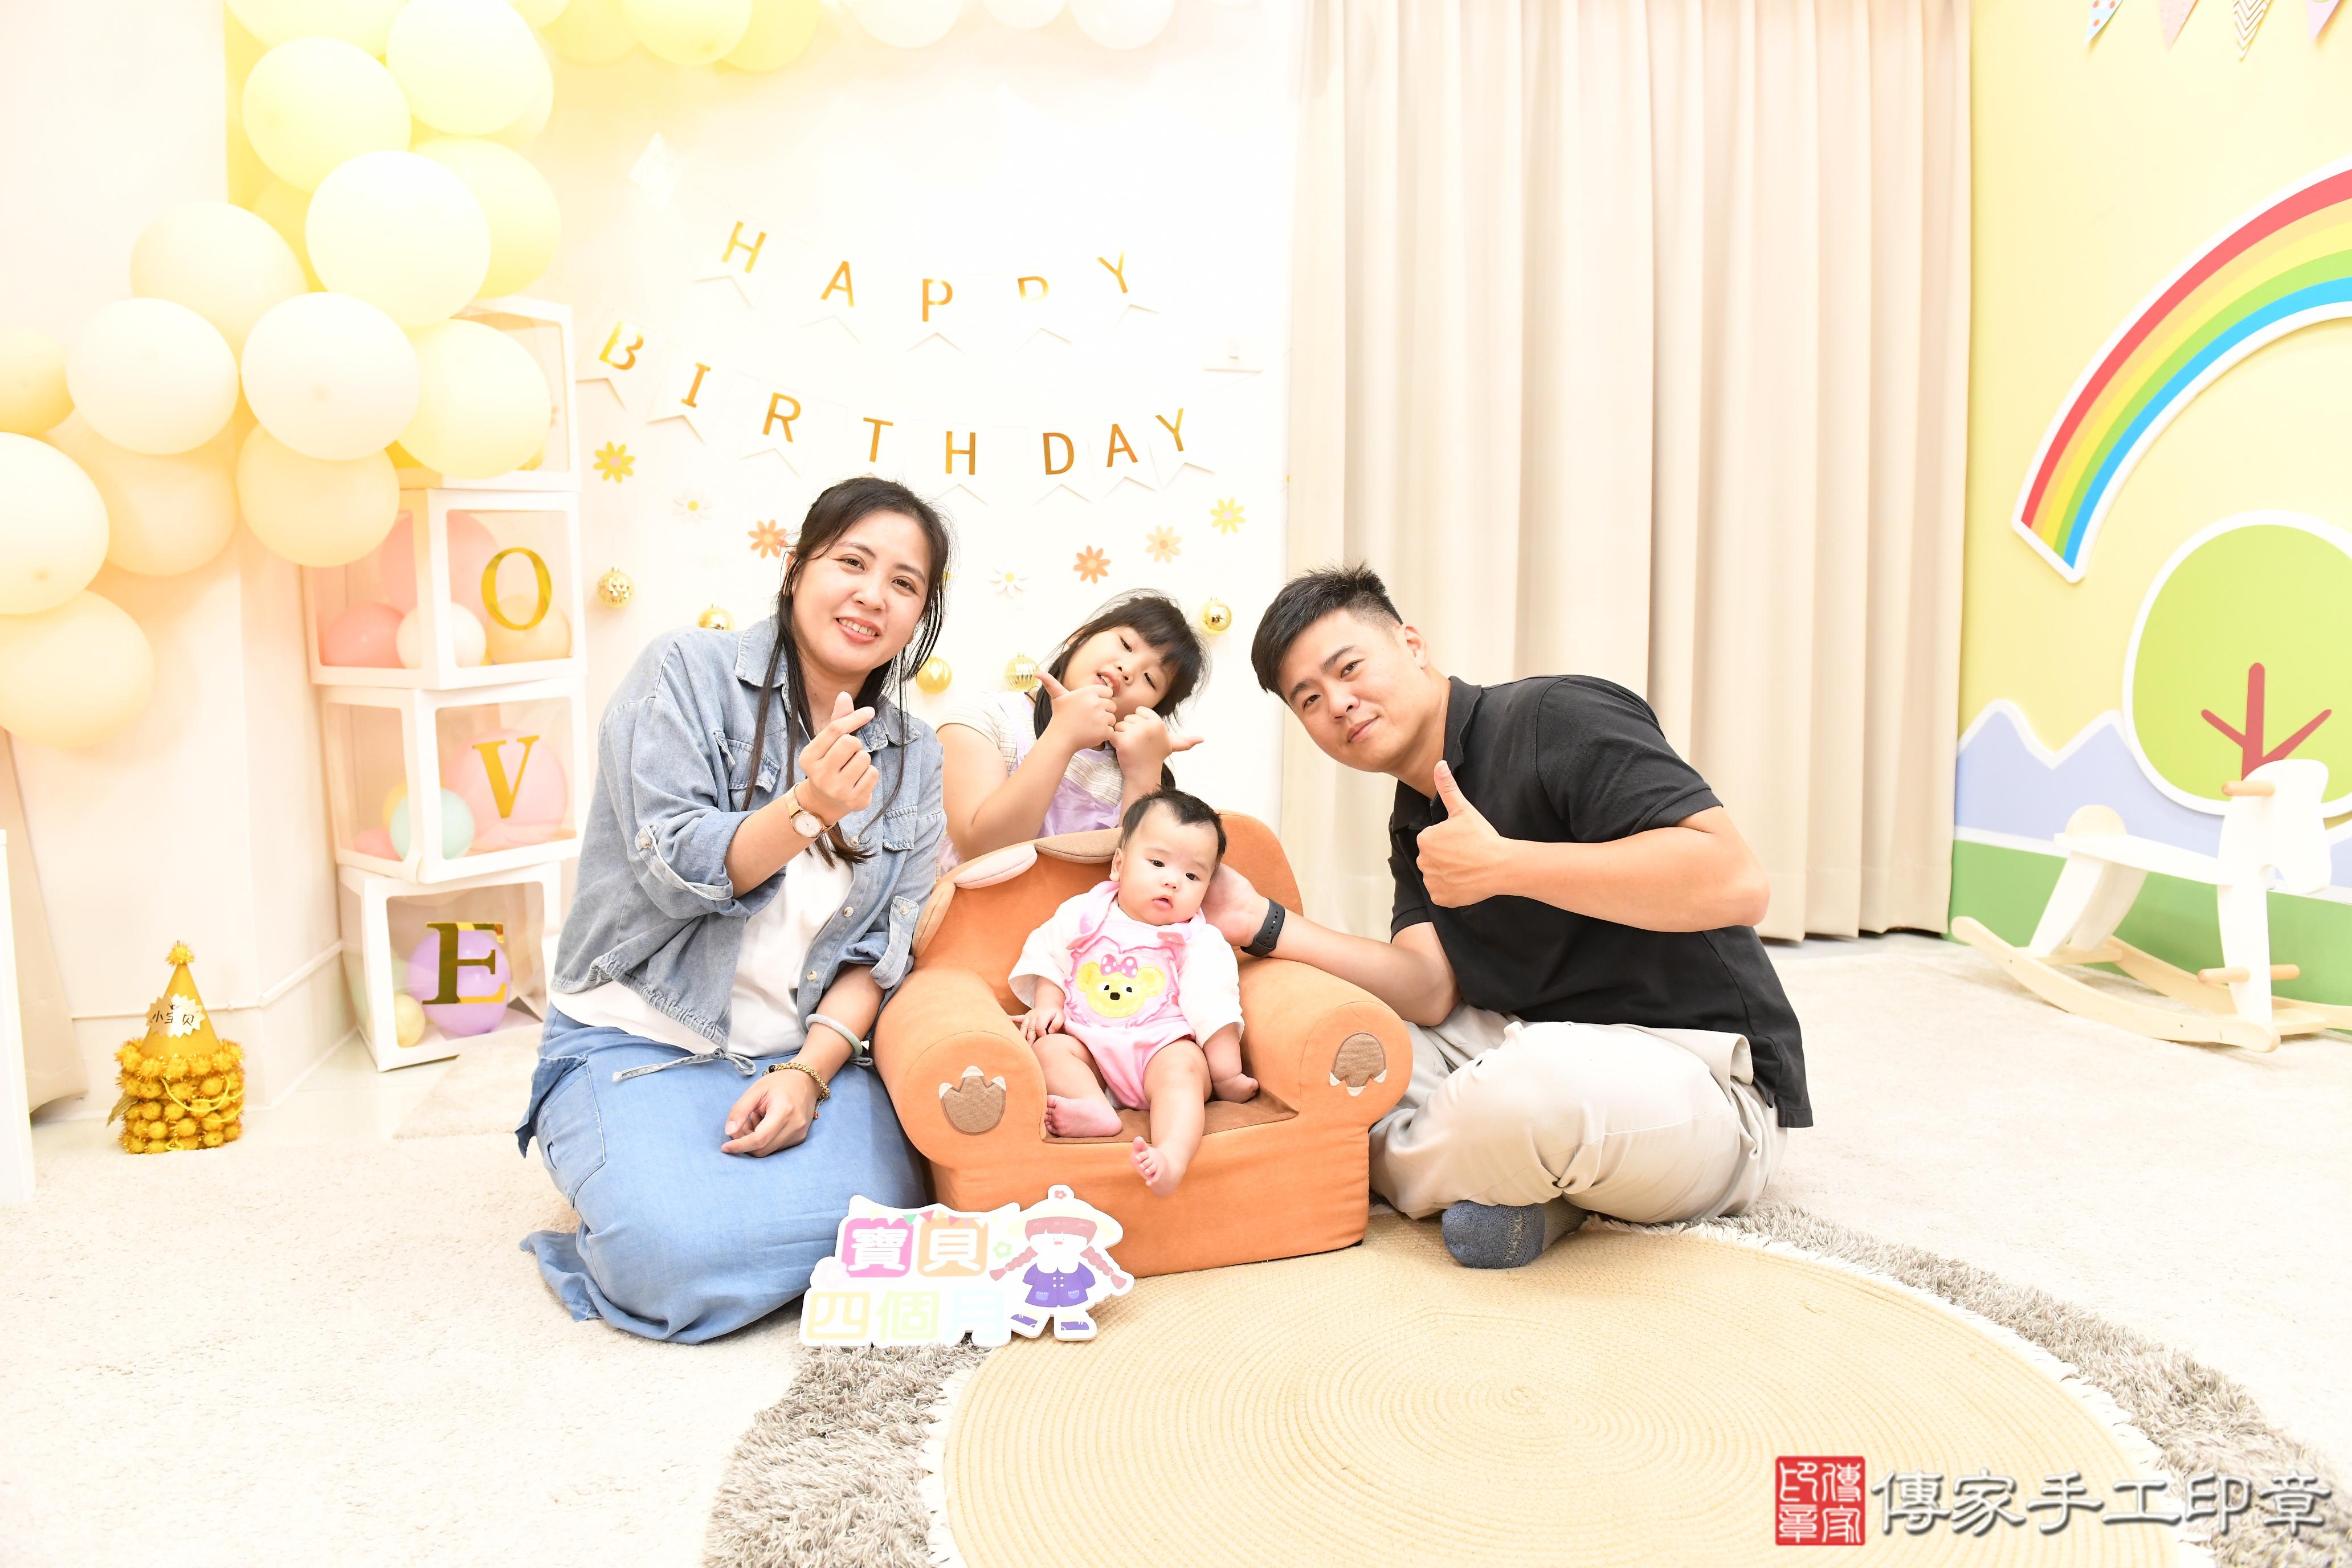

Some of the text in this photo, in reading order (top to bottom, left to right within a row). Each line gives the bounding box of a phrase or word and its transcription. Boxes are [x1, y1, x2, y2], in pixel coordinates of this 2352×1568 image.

[720, 220, 1129, 322] HAPPY
[598, 320, 1186, 476] BIRTHDAY
[847, 1224, 984, 1272] 寶貝
[806, 1289, 1007, 1341] 四個月
